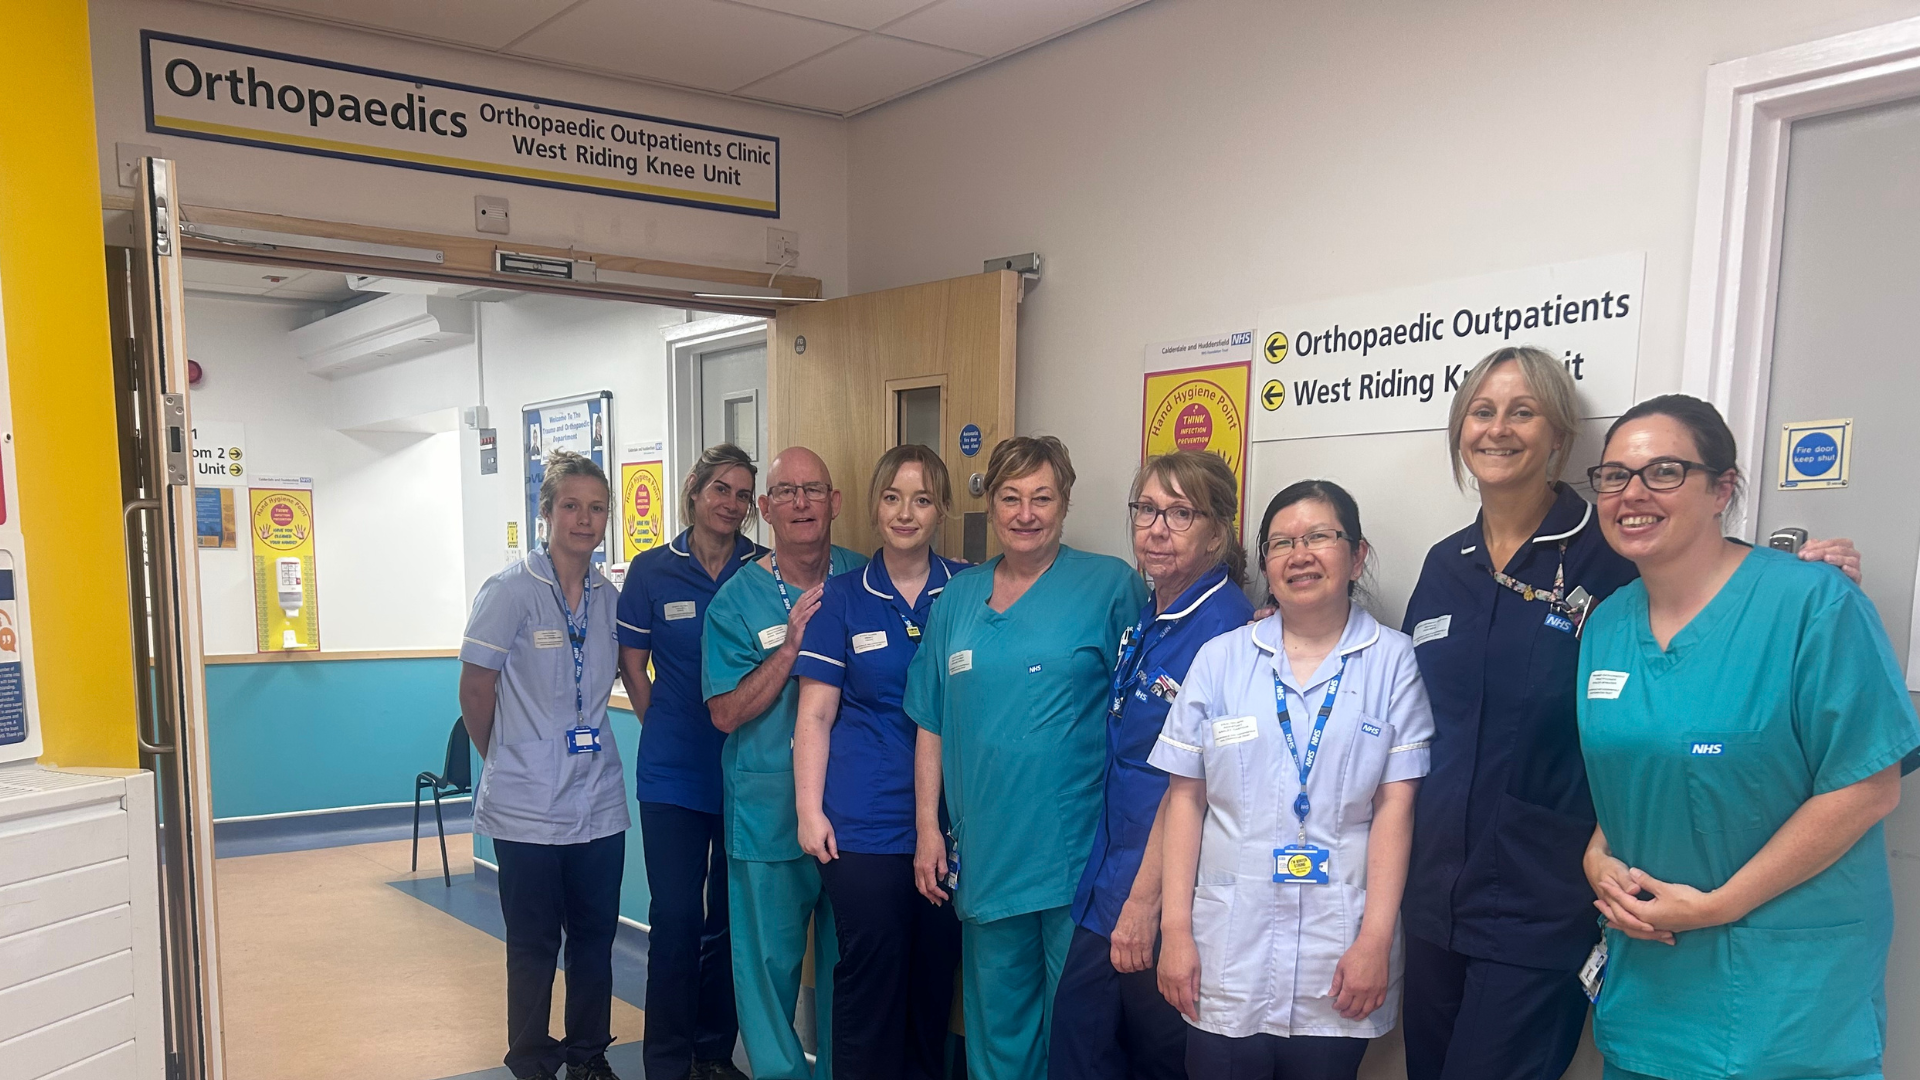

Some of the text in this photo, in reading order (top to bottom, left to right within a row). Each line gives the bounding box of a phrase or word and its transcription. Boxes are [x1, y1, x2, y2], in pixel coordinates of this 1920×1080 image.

[165, 58, 468, 138] Orthopaedics
[479, 102, 771, 166] Orthopaedic Outpatients Clinic
[512, 134, 741, 186] West Riding Knee Unit
[1295, 290, 1630, 357] Orthopaedic Outpatients
[1161, 338, 1230, 354] Calderdale and Huddersfield
[1231, 332, 1251, 345] NHS
[1293, 376, 1351, 406] West
[1359, 368, 1434, 403] Riding
[1151, 385, 1238, 436] Hand Hygiene Point
[1183, 415, 1206, 425] THINK
[1180, 427, 1207, 435] INFECTION
[1177, 436, 1210, 445] PREVENTION
[217, 447, 225, 459] 2
[199, 462, 226, 475] Unit
[256, 496, 307, 517] Hand Hygiene Point
[1546, 615, 1572, 631] NHS
[1029, 664, 1042, 674] NHS
[1275, 685, 1285, 700] NHS
[1327, 679, 1339, 695] NHS
[1113, 696, 1121, 711] NHS
[1362, 723, 1380, 735] NHS
[1286, 733, 1295, 750] NHS
[1311, 729, 1322, 746] NHS
[1692, 743, 1722, 755] NHS
[1305, 749, 1315, 768] NHS
